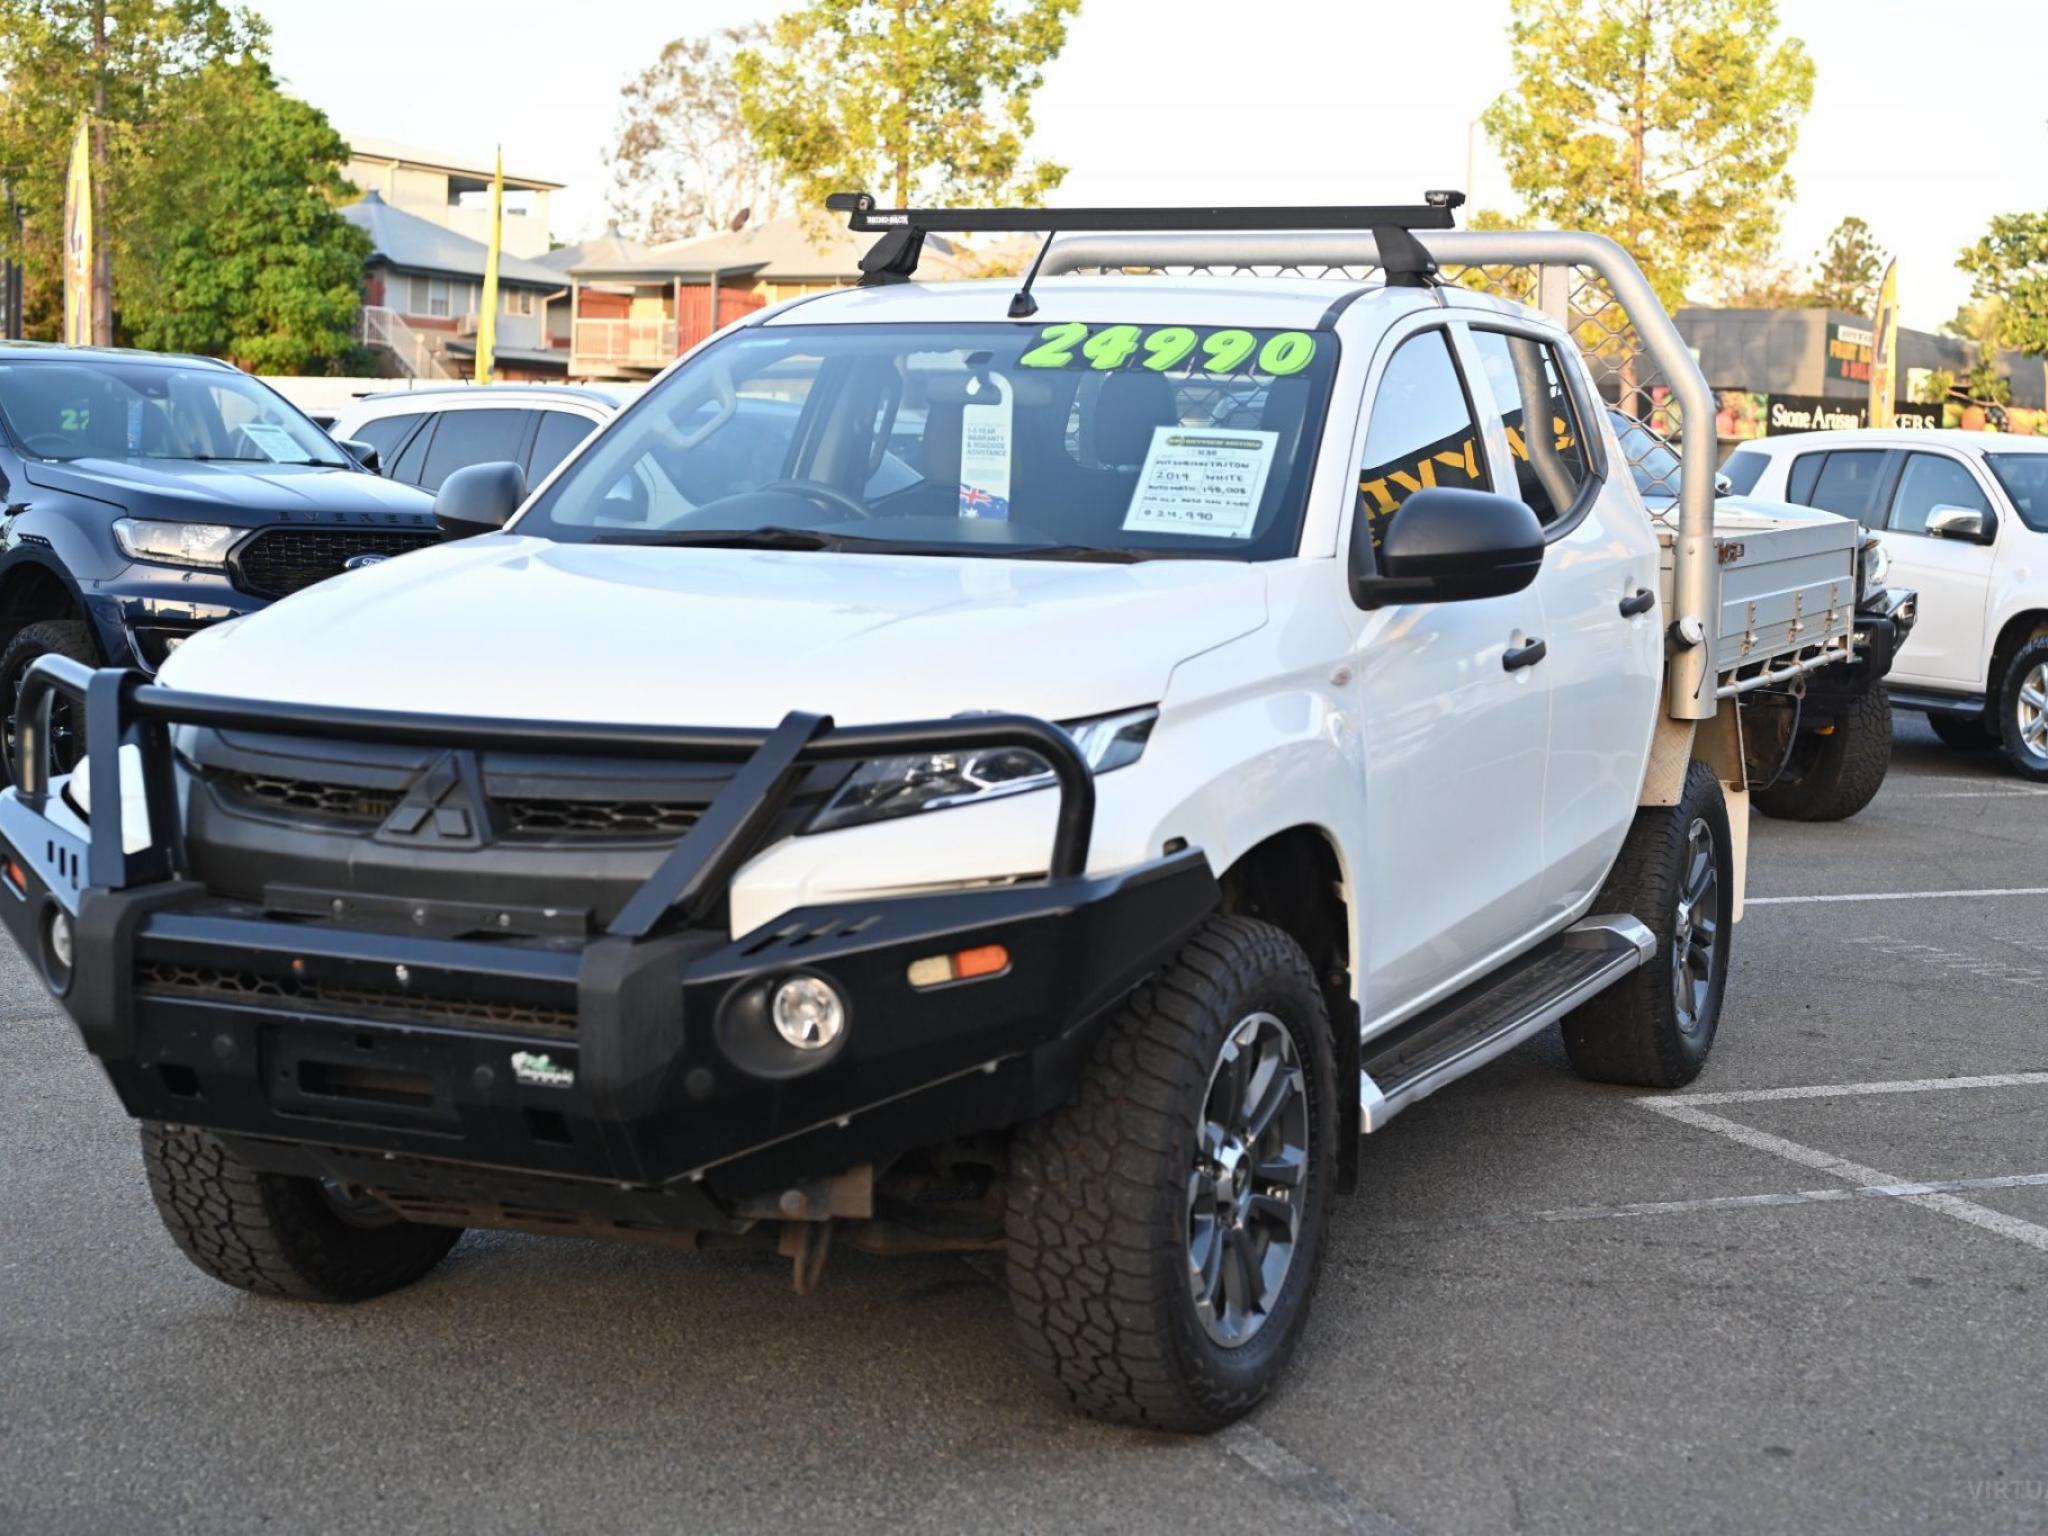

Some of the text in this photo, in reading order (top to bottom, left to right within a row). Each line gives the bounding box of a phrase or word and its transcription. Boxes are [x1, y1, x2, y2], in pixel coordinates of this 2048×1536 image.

[1020, 322, 1316, 376] 24990
[1157, 472, 1190, 481] 2019
[278, 511, 424, 524] EVERES
